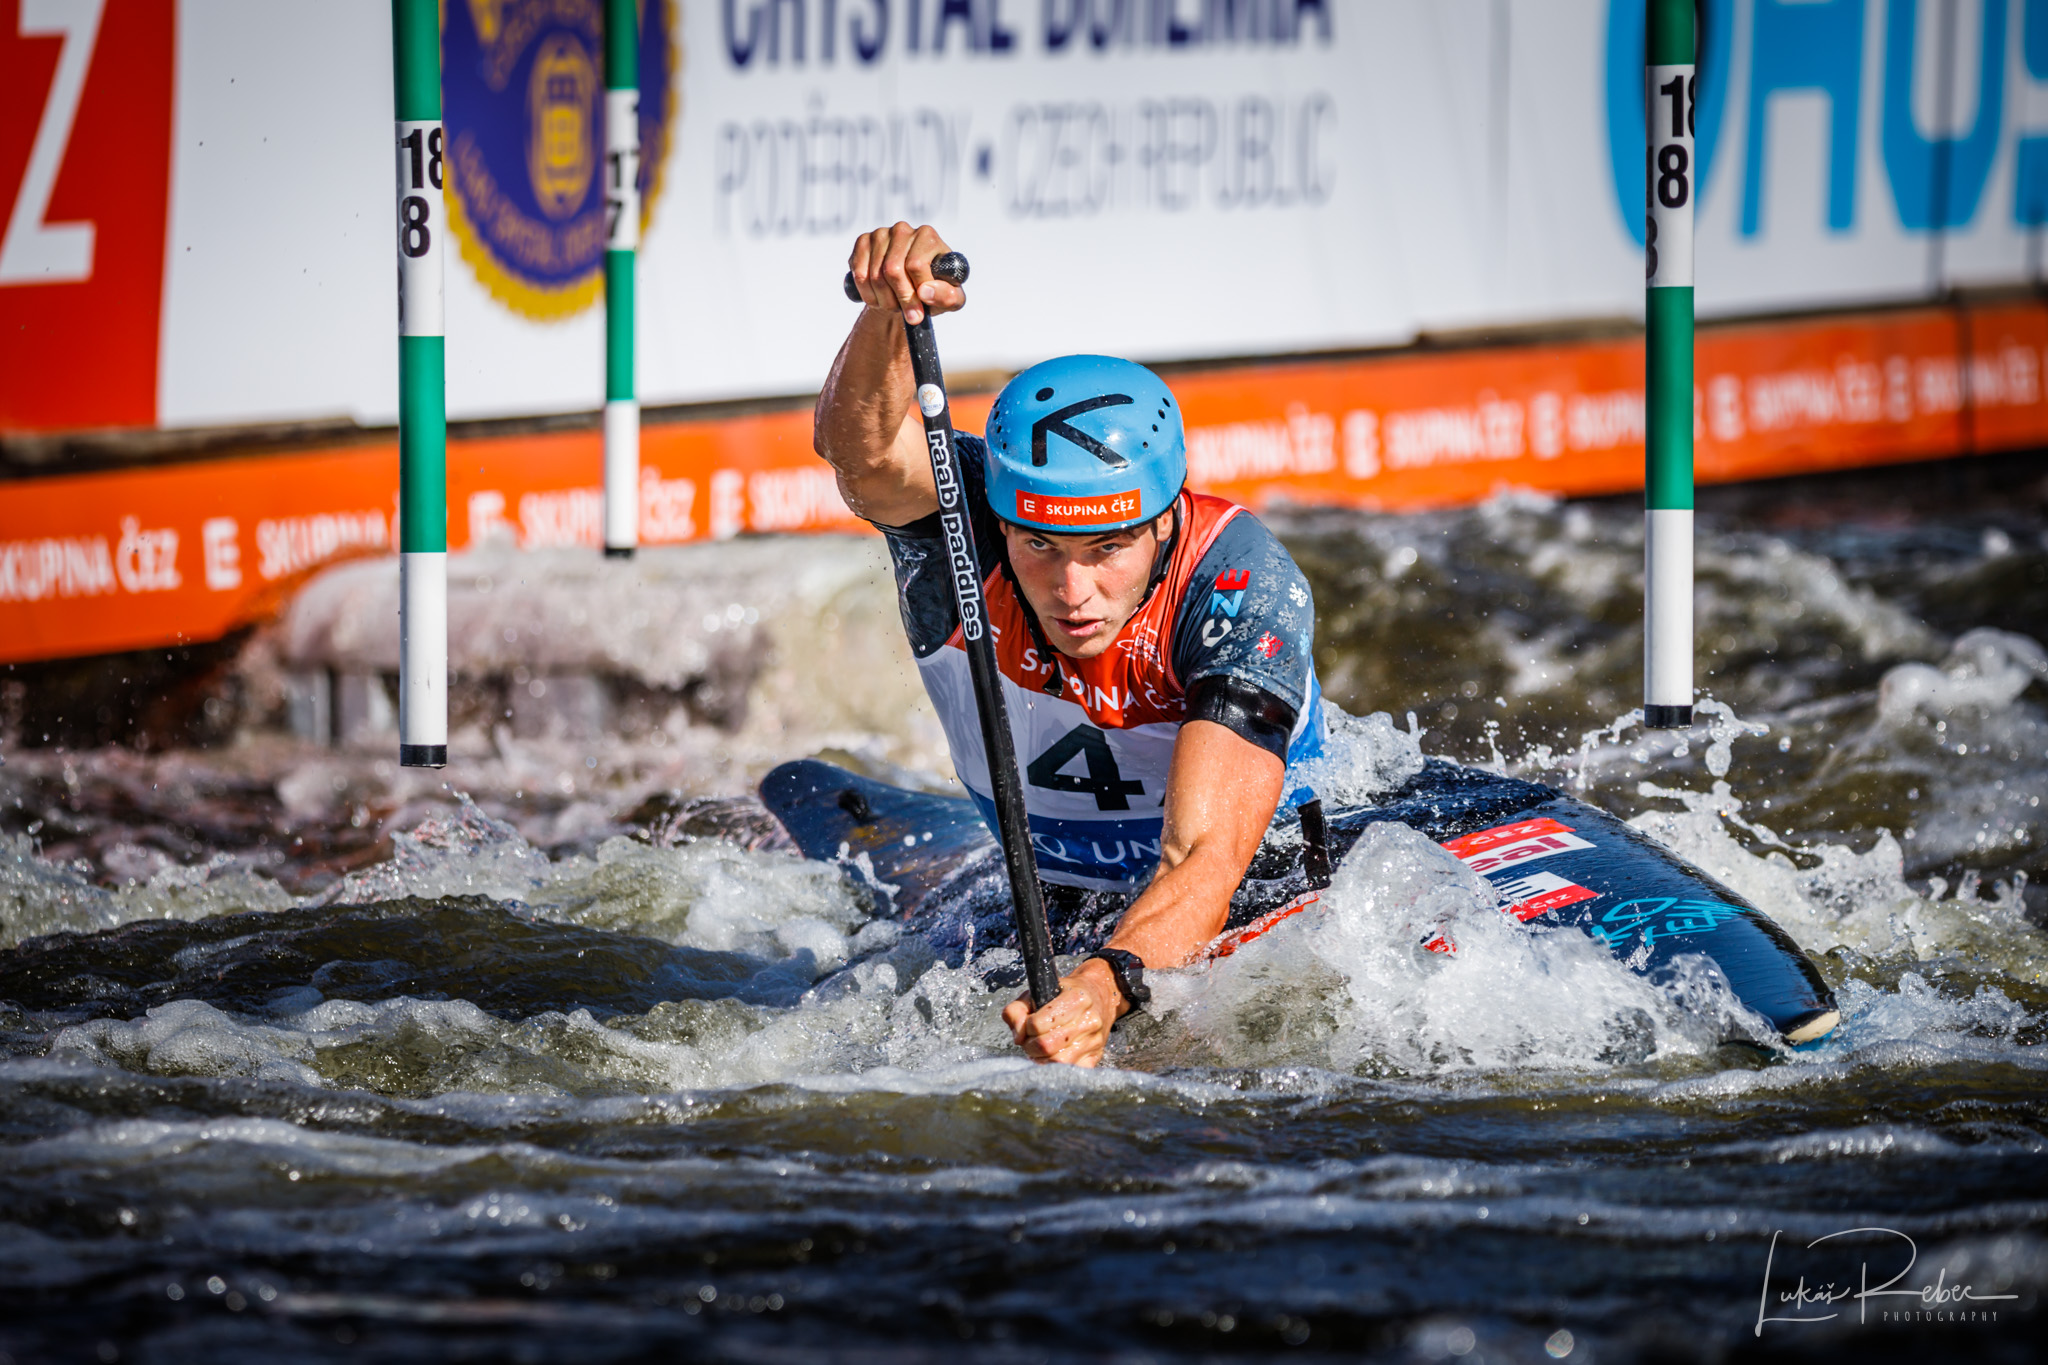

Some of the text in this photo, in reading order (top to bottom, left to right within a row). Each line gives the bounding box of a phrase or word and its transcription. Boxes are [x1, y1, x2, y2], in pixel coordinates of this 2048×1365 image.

[927, 429, 960, 508] raab
[1046, 503, 1108, 516] SKUPINA
[1111, 498, 1135, 513] ČEZ
[941, 512, 983, 641] paddles
[1202, 568, 1251, 648] CZE
[1027, 723, 1146, 811] 4
